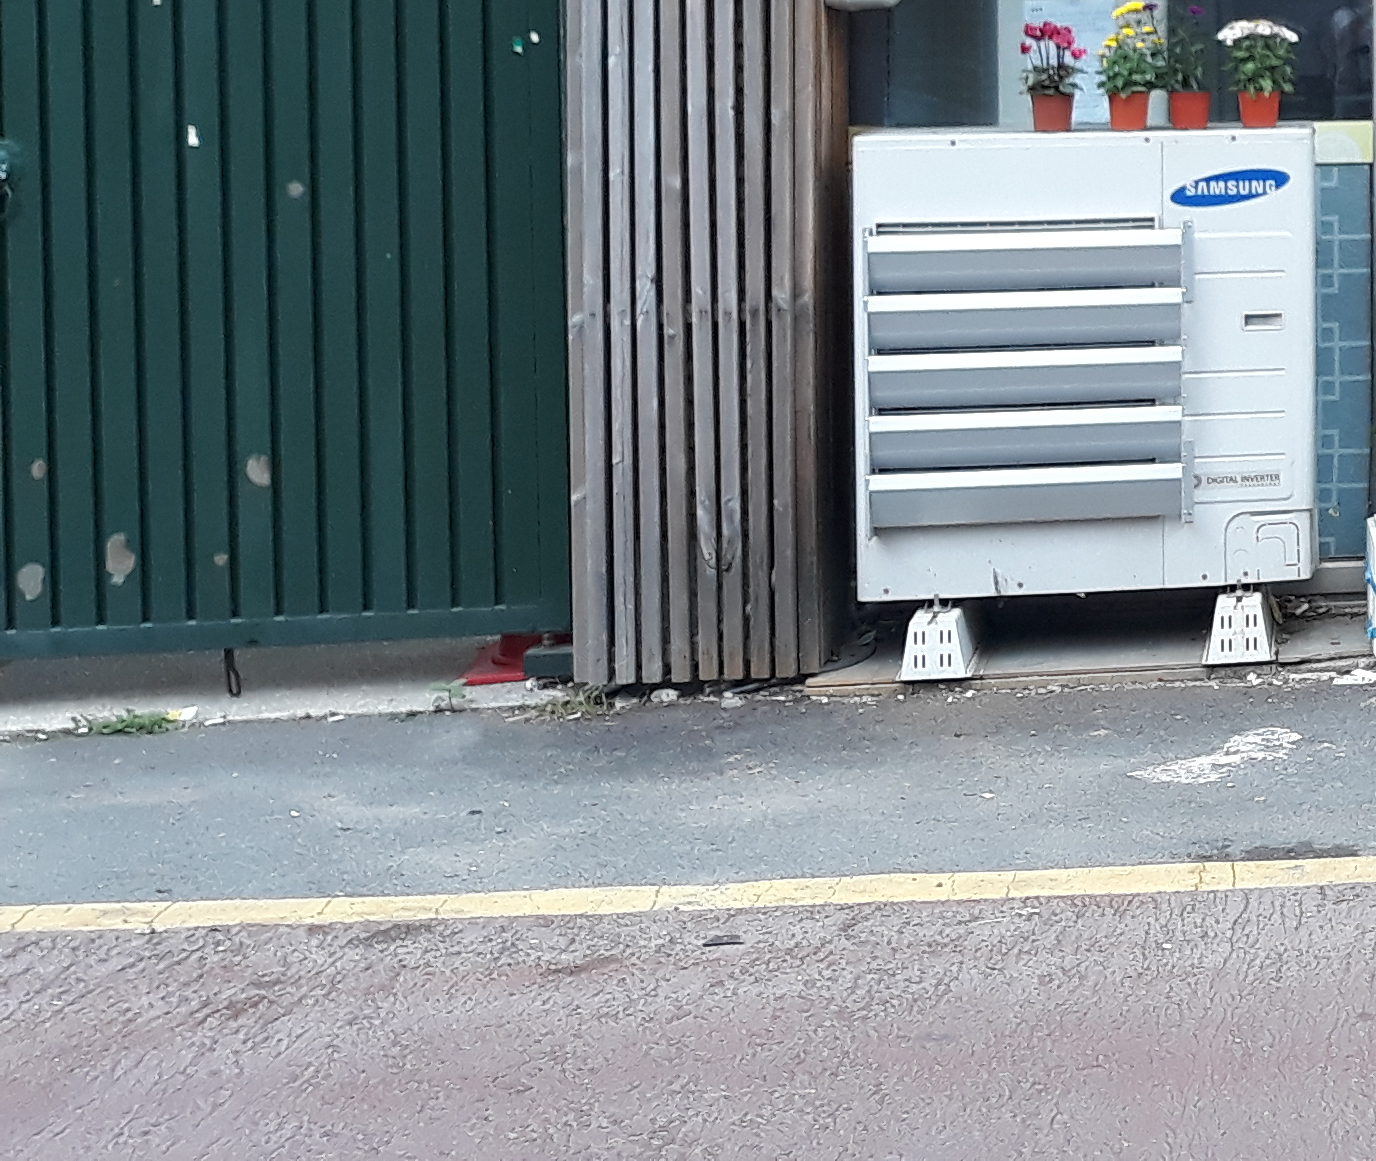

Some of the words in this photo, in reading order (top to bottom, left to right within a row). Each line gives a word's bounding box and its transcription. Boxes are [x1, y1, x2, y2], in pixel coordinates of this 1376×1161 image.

[1185, 179, 1277, 197] SAMSUNG
[1206, 475, 1239, 485] DIGITAL
[1240, 473, 1280, 483] INVERTER
